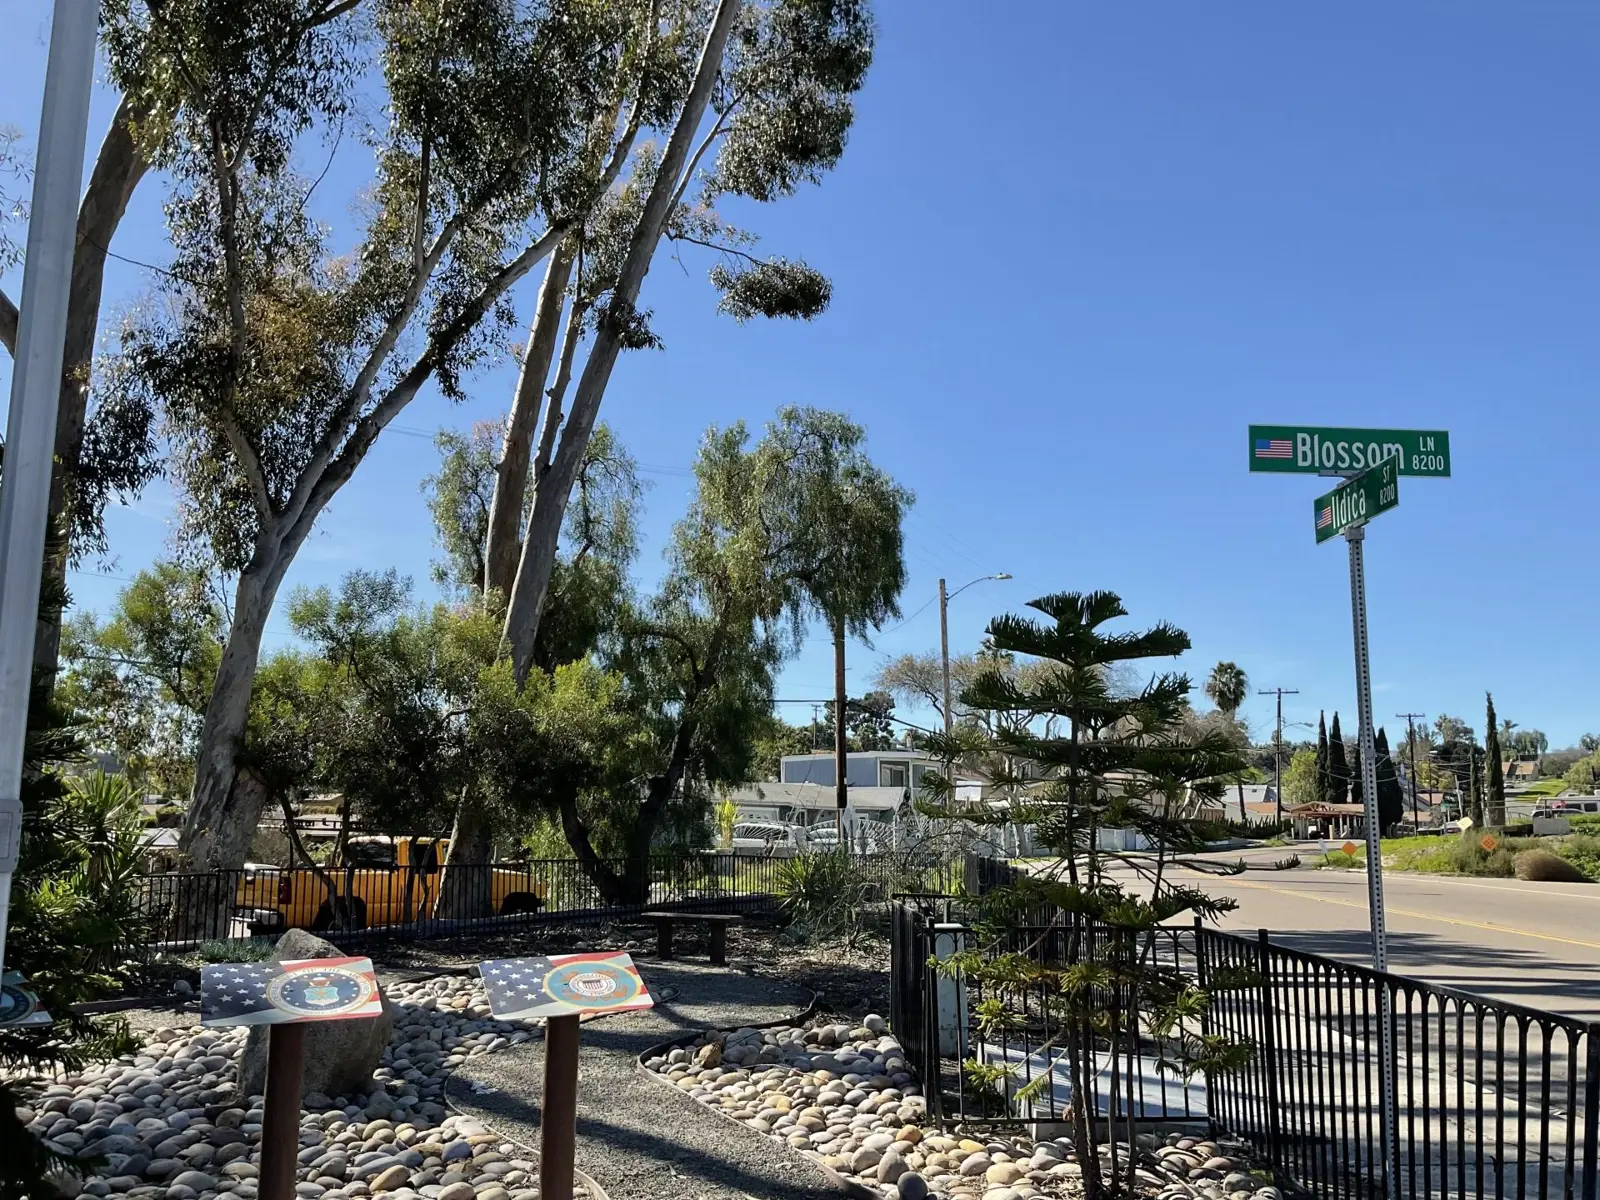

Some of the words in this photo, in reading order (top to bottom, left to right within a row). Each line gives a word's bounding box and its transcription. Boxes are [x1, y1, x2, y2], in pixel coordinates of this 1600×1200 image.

[1296, 432, 1404, 469] Blossom
[1419, 436, 1435, 452] LN
[1412, 454, 1445, 471] 8200
[1331, 487, 1367, 530] Ildica
[1382, 464, 1391, 484] ST
[1379, 483, 1396, 506] 8200
